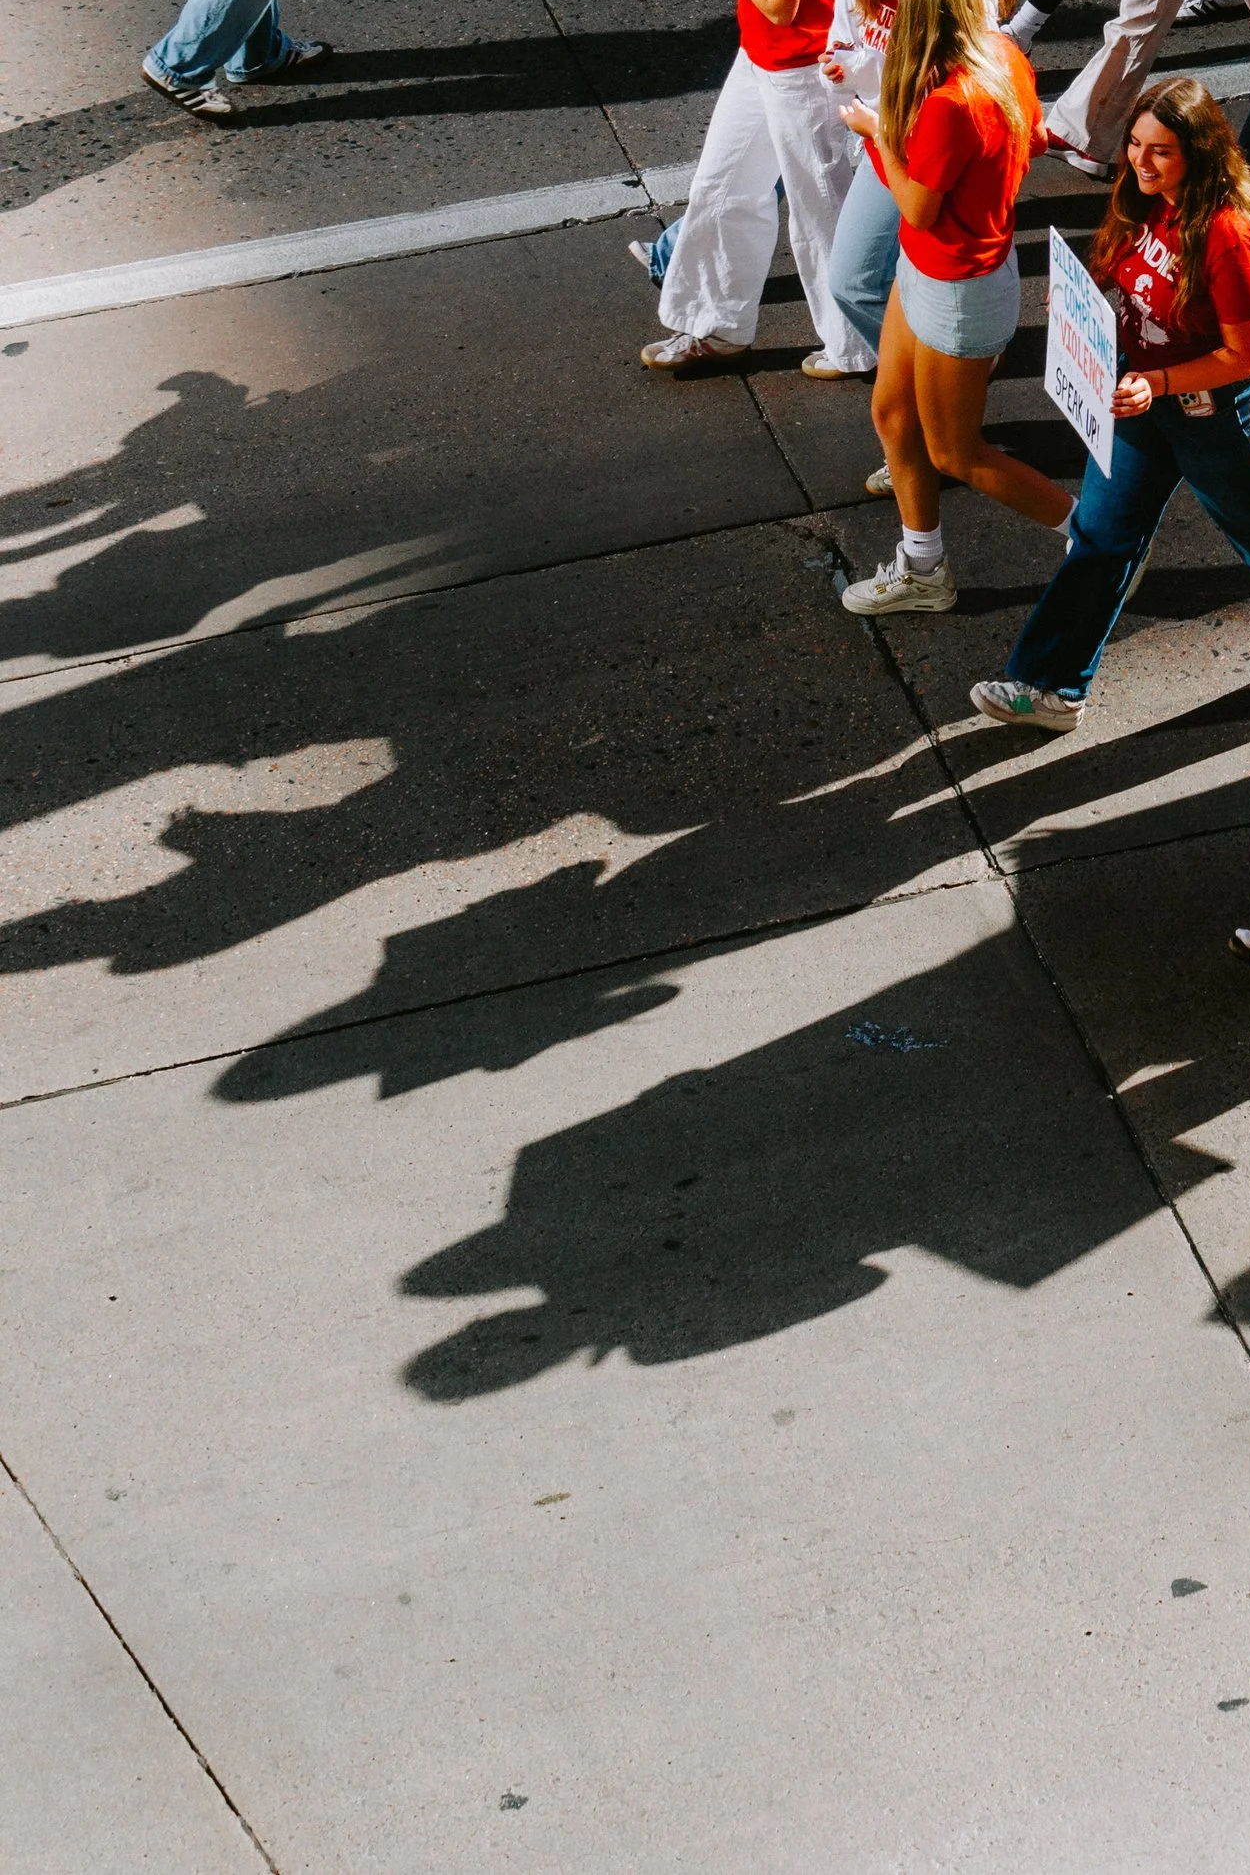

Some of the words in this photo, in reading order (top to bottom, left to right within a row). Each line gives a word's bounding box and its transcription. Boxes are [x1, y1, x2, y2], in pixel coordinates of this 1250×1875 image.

[1053, 235, 1091, 309] SILENCE
[1059, 313, 1105, 405] VIOLENCE
[1064, 282, 1115, 378] COMPLIANCE
[1055, 366, 1084, 429] SPEAK
[1085, 411, 1101, 450] UP!
